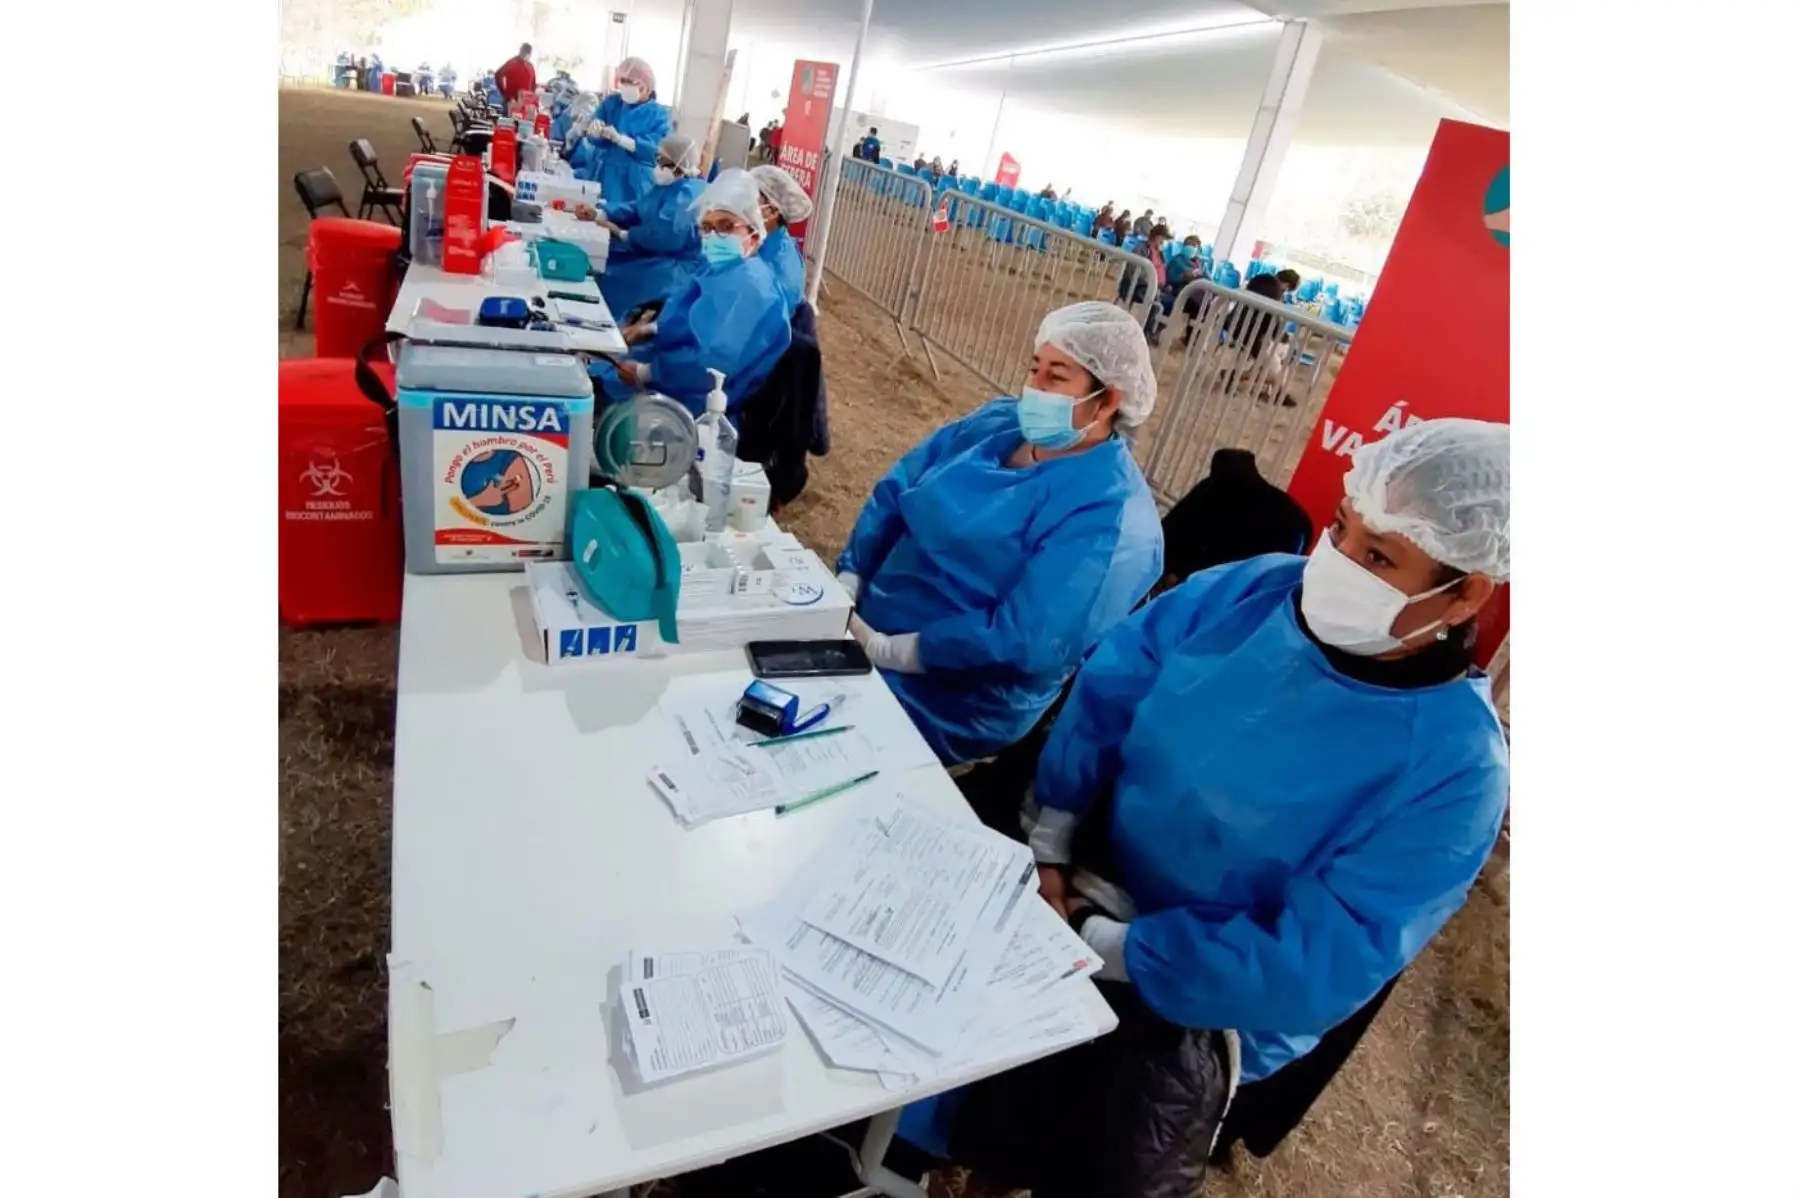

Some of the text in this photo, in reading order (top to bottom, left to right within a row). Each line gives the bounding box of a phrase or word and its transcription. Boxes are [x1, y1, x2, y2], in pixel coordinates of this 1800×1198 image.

[779, 141, 818, 171] ÁREA DE
[780, 163, 812, 189] PERA
[443, 402, 561, 431] MINSA
[444, 454, 464, 484] Pongo
[462, 444, 472, 456] el
[472, 436, 518, 450] hombro
